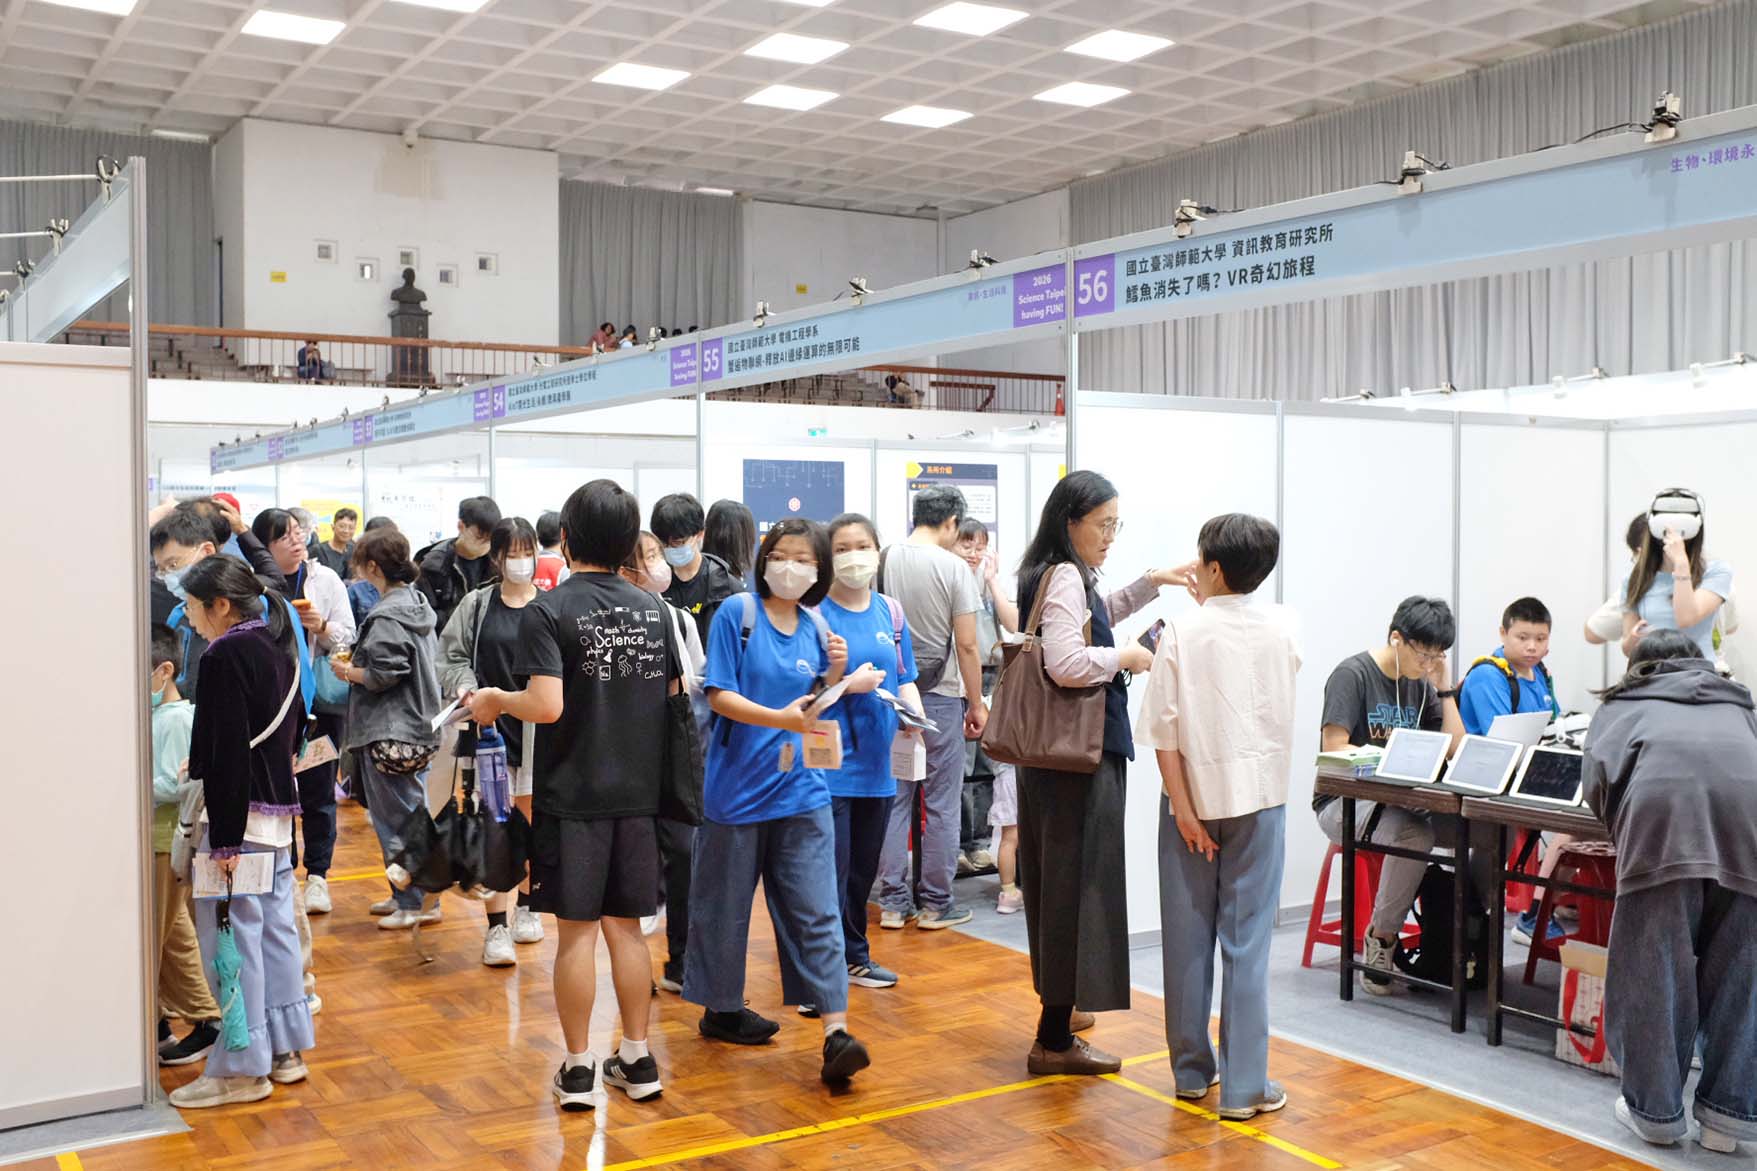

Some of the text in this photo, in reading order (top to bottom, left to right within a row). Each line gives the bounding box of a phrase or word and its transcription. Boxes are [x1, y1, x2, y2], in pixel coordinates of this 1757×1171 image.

[1126, 223, 1333, 277] 國立臺灣師範大學 資訊教育研究所
[1227, 255, 1315, 287] VR奇幻旅程
[1018, 290, 1044, 304] Science
[1078, 270, 1108, 304] 56
[1021, 308, 1044, 321] having
[703, 349, 720, 373] 55
[493, 391, 504, 411] 54
[594, 625, 645, 648] Science
